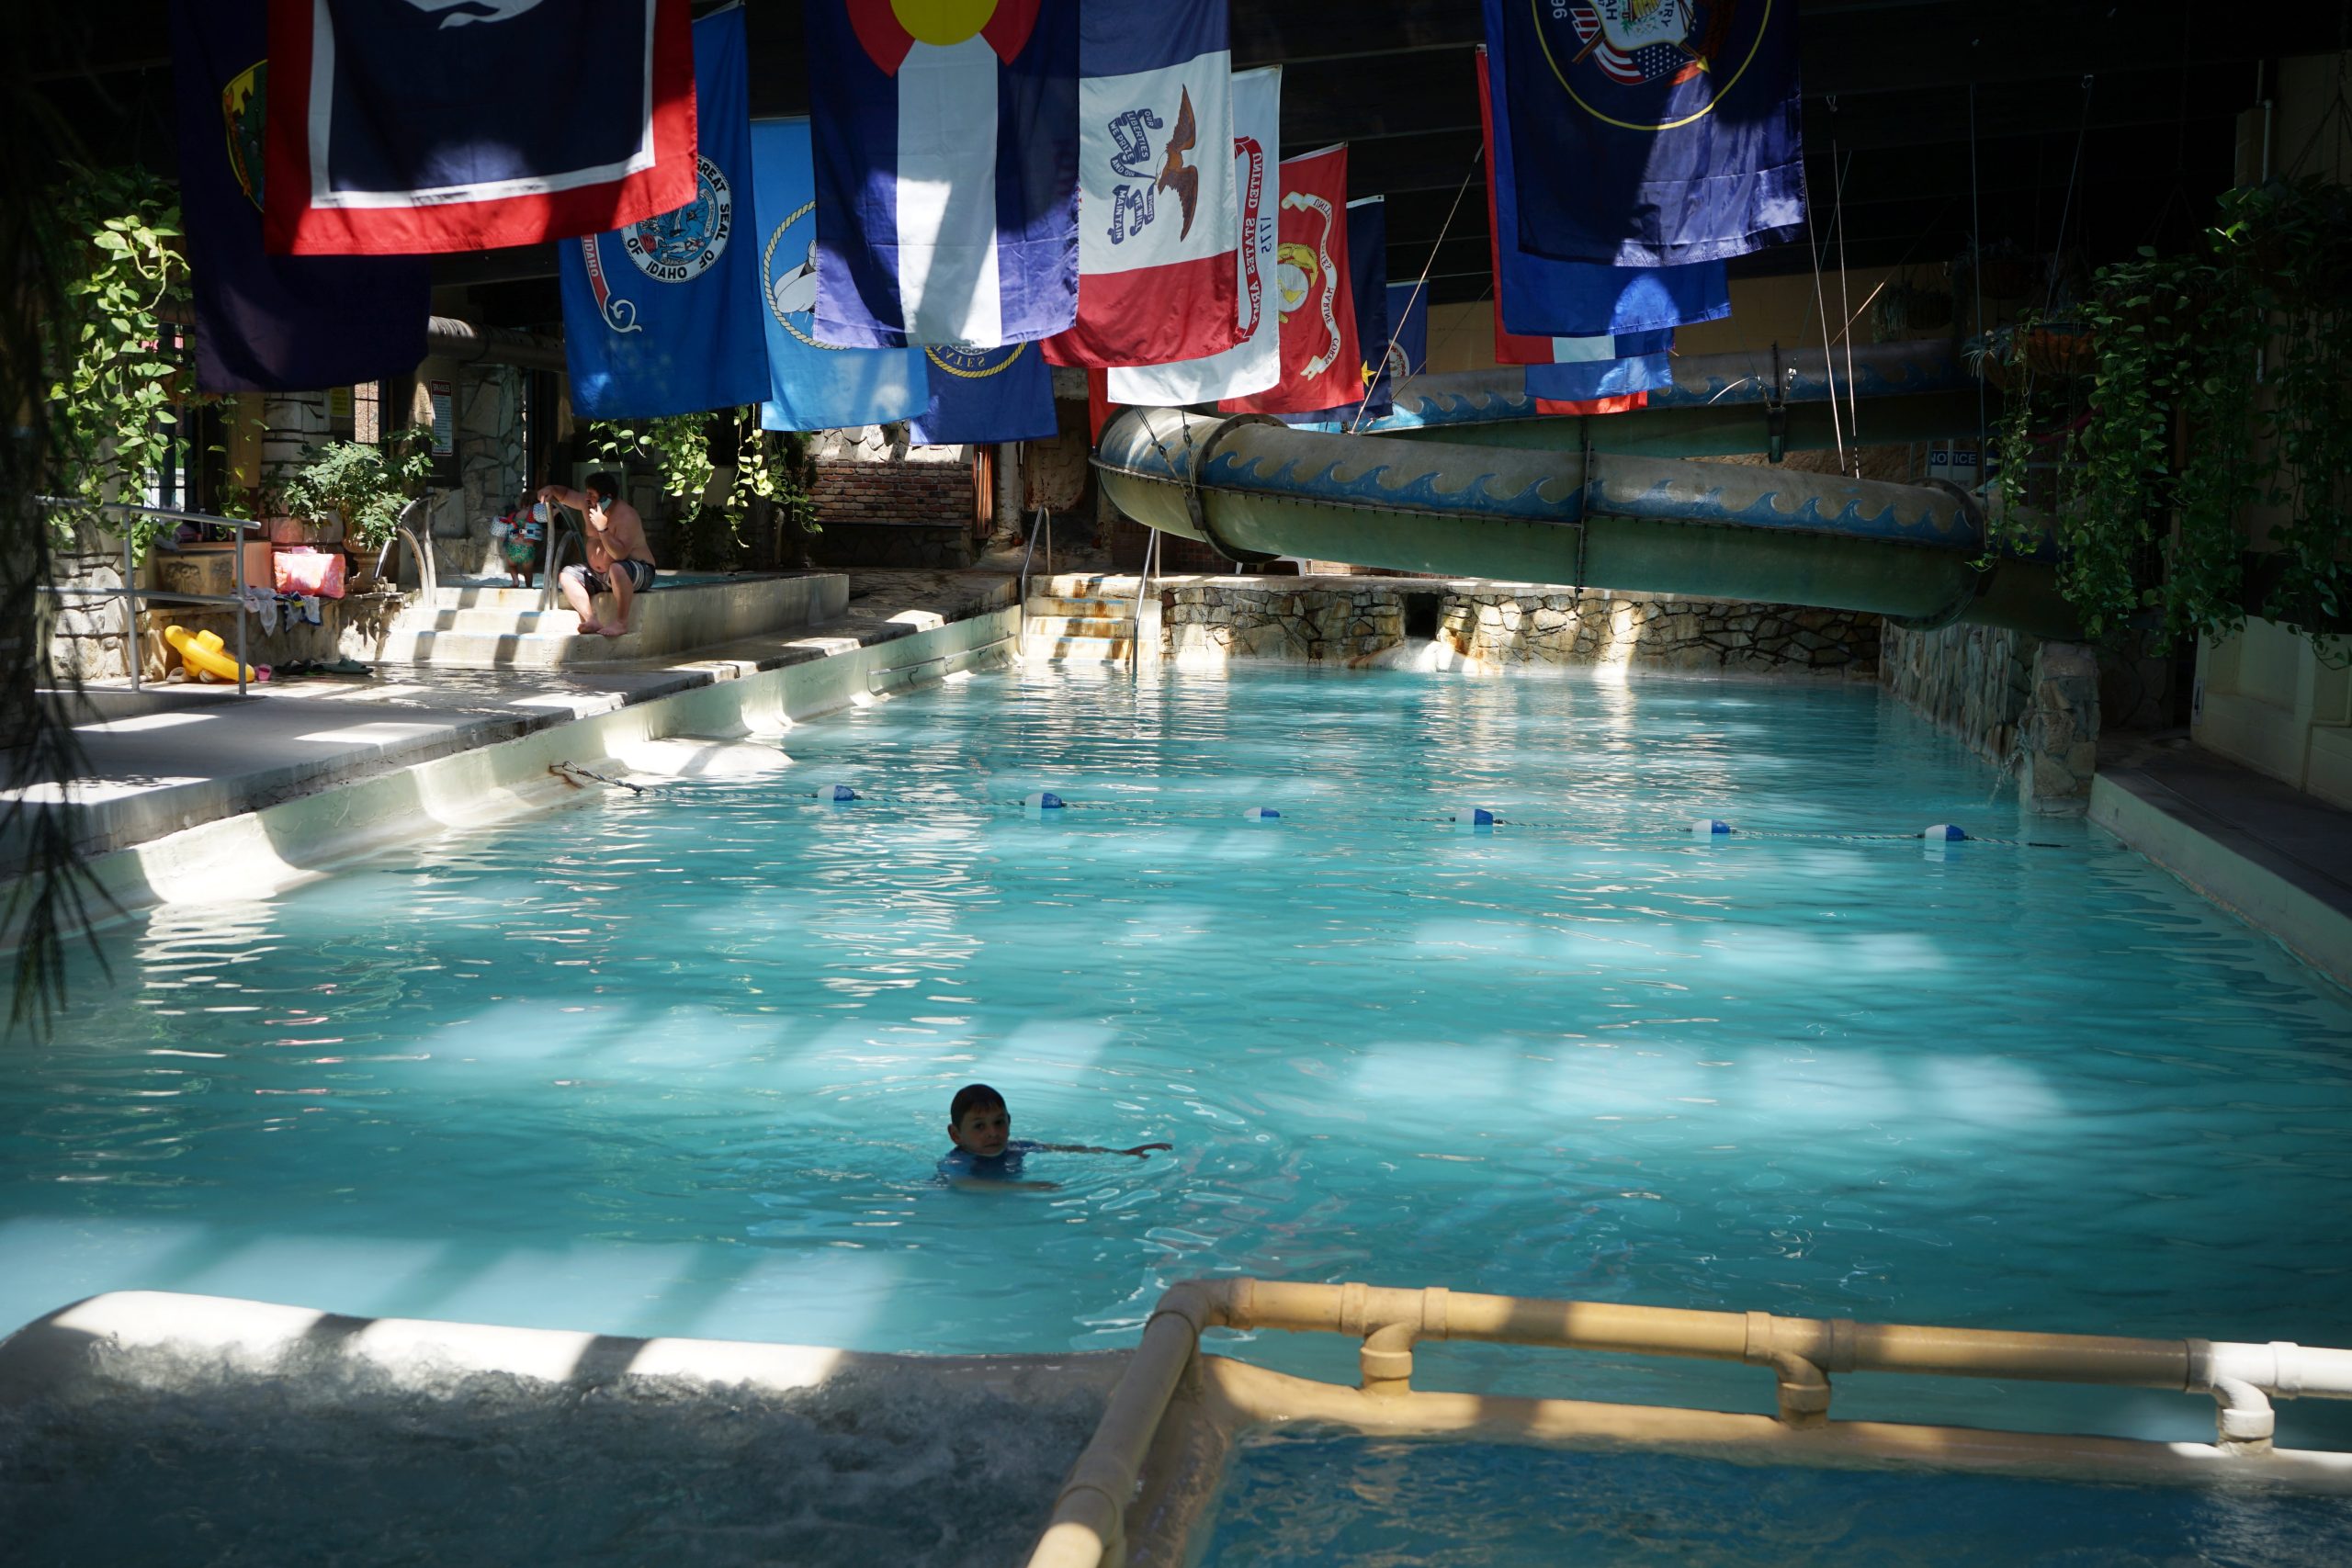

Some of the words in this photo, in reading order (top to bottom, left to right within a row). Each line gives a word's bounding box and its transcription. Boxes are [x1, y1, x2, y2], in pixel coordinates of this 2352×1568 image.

[1126, 112, 1149, 158] LIBERTIES
[1144, 110, 1155, 128] OUR
[1109, 121, 1118, 135] WE
[1116, 134, 1135, 161] PRIZE
[1112, 159, 1125, 174] AND
[1114, 190, 1126, 240] MAINTAIN
[1134, 194, 1143, 209] WE
[715, 203, 730, 242] SEAL
[1135, 209, 1144, 233] WILL
[582, 239, 599, 277] IDAHO
[627, 237, 644, 256] OF
[645, 261, 688, 279] IDAHO
[699, 250, 715, 269] OF
